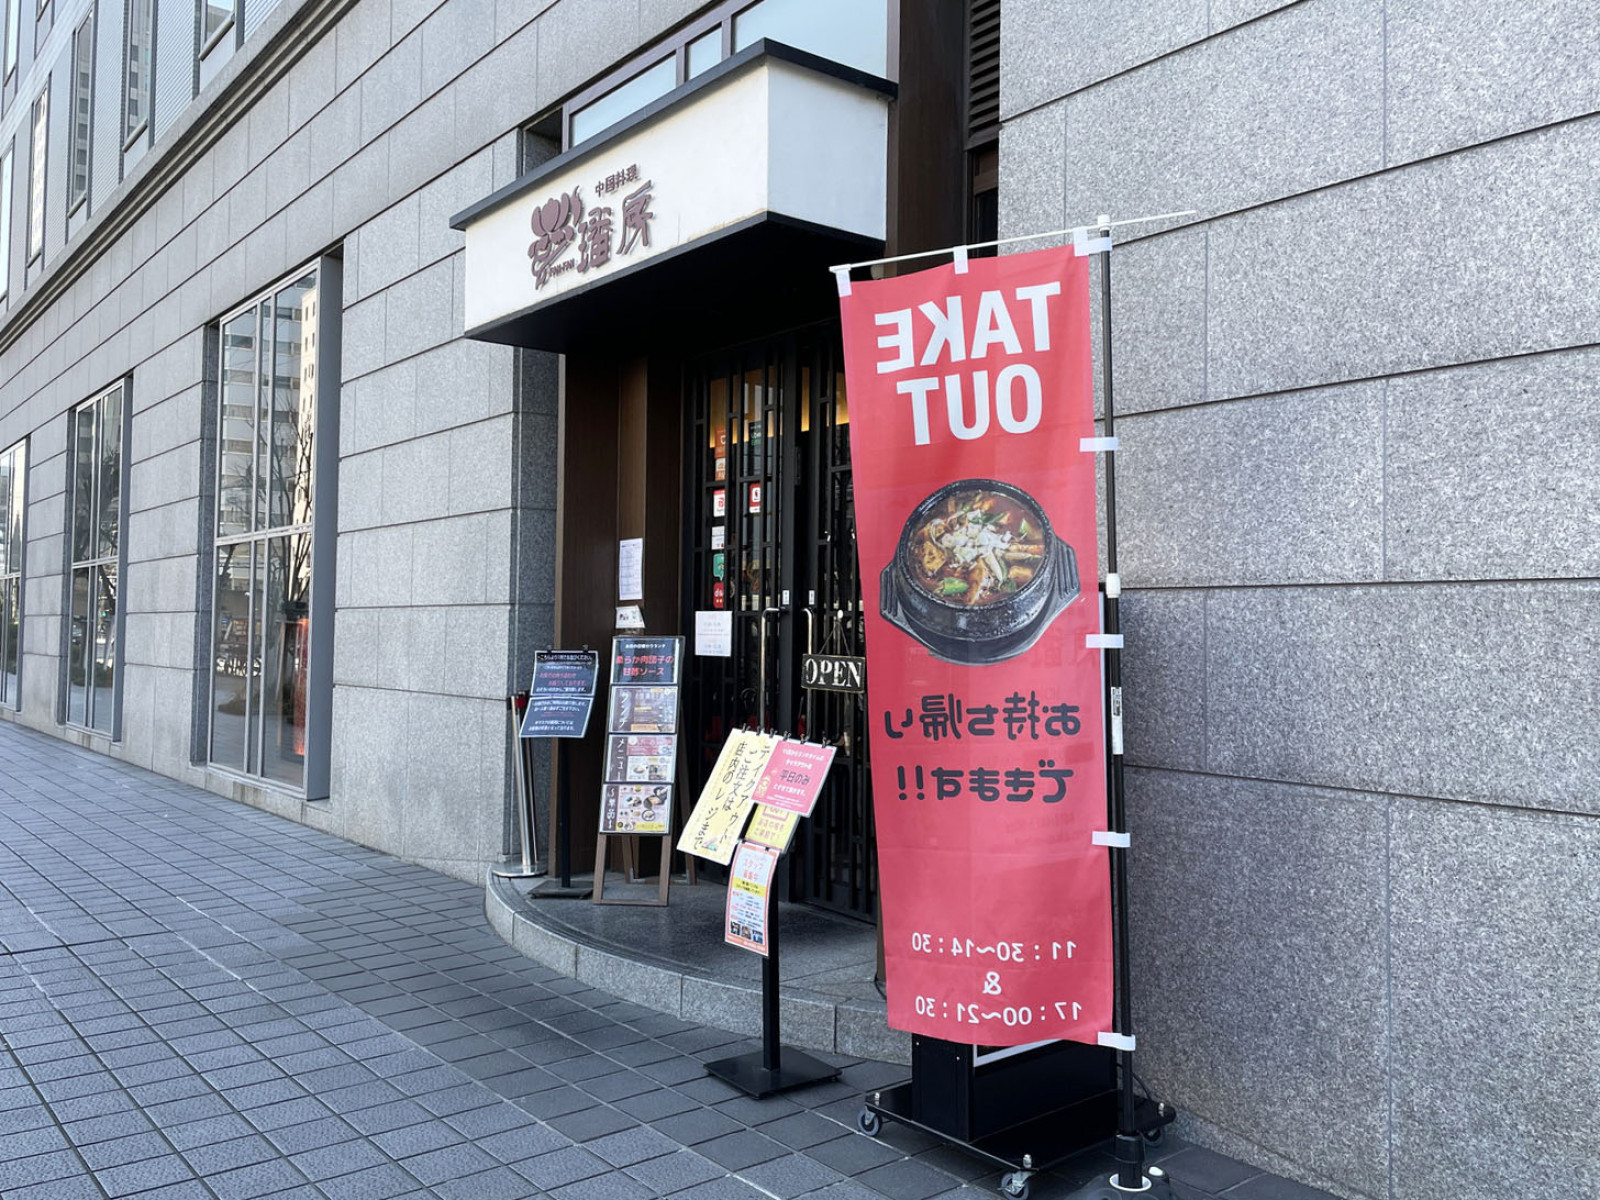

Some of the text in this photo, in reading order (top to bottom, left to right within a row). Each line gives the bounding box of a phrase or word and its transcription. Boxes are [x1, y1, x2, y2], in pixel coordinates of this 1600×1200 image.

[595, 164, 640, 197] 中国料理
[805, 658, 862, 688] OPEN
[722, 750, 757, 812] ご注文は
[780, 769, 811, 785] 平日のみ
[719, 745, 771, 844] テイクアウト
